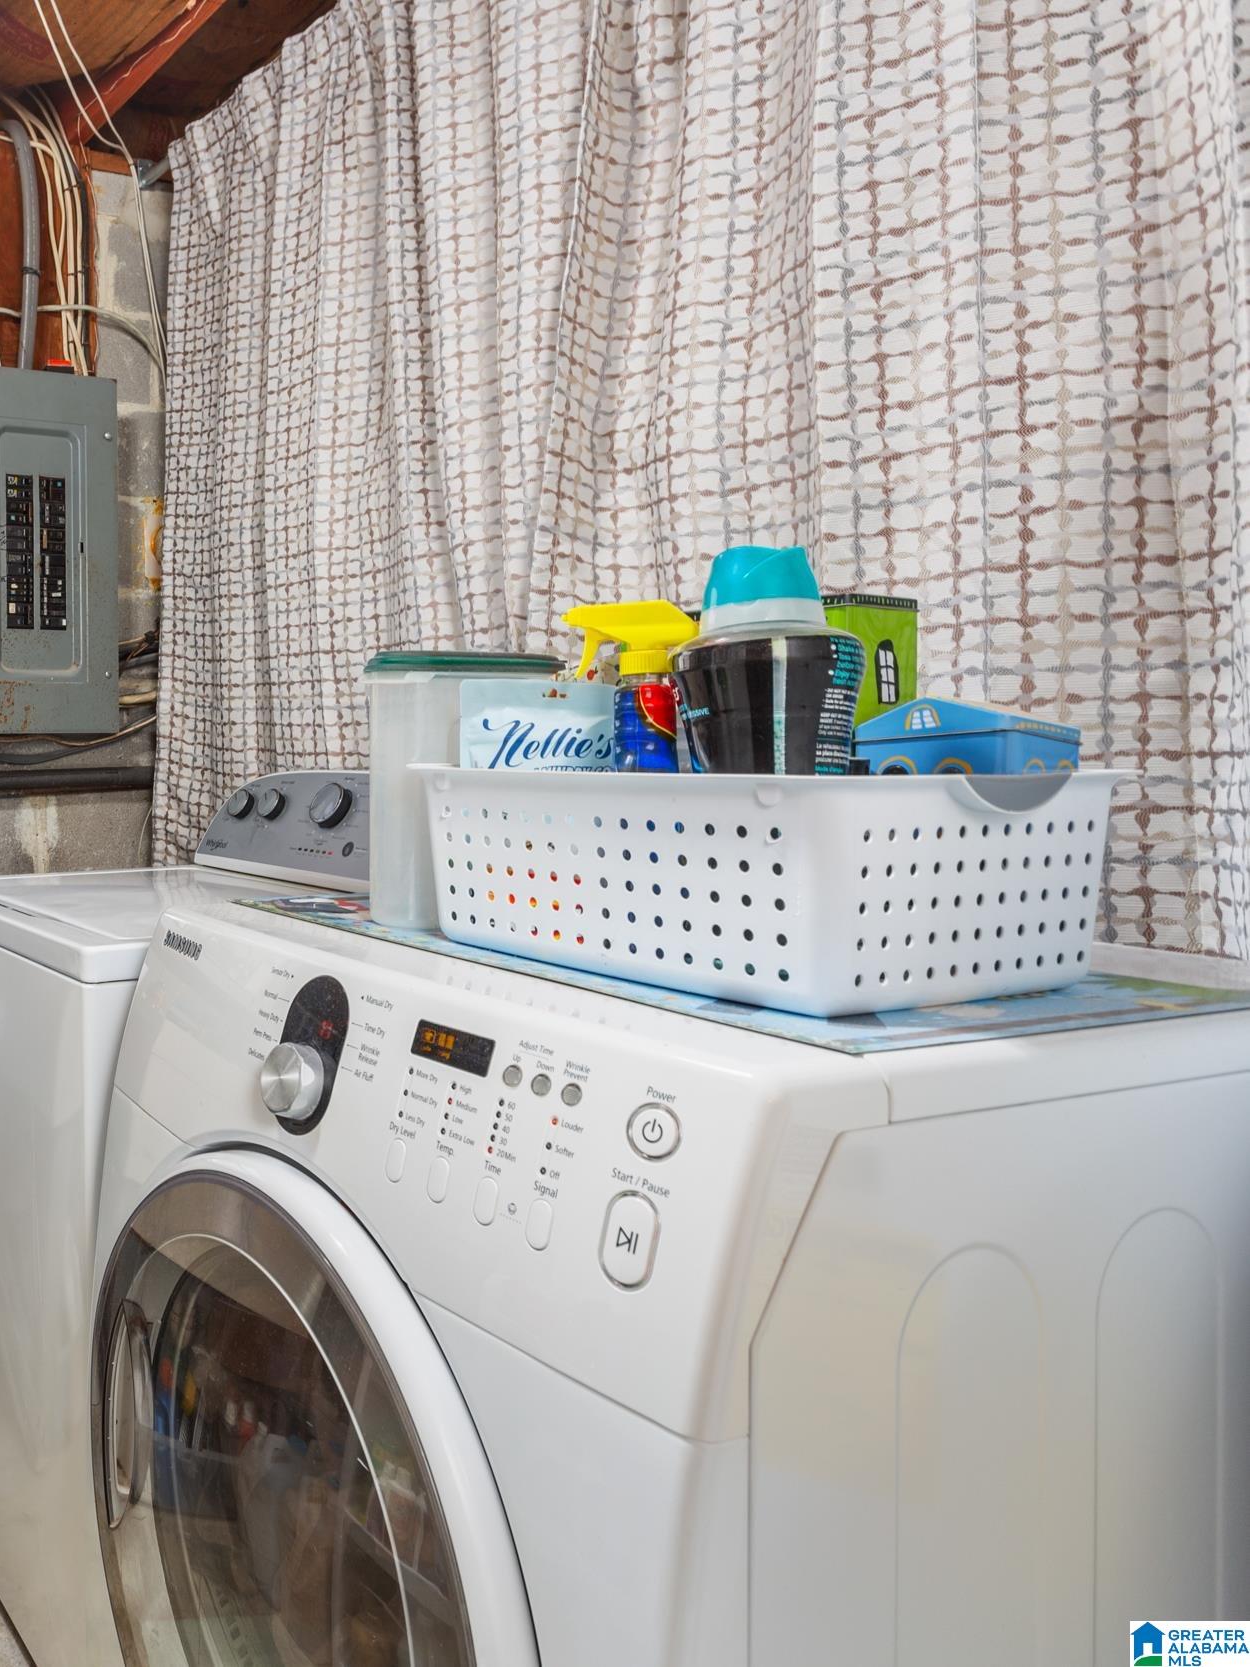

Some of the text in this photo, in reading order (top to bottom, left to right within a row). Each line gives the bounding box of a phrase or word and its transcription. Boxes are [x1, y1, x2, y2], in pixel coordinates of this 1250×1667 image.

[482, 718, 614, 770] Nellie's
[163, 930, 203, 960] SAMSUNG
[366, 995, 394, 1011] Manual Dry
[364, 1022, 386, 1038] Time Dry
[519, 1040, 555, 1056] Adjust Time
[512, 1054, 522, 1063] Up
[536, 1060, 555, 1073] Down
[566, 1059, 591, 1074] Wrinkle
[429, 1073, 438, 1084] Dry
[564, 1068, 588, 1082] Prevent
[459, 1084, 472, 1096] High
[646, 1086, 676, 1103] Power
[429, 1096, 438, 1108] Dry
[456, 1100, 478, 1114] Medium
[508, 1101, 516, 1111] 60
[416, 1116, 425, 1128] Dry
[452, 1114, 464, 1125] Low
[505, 1113, 514, 1122] 50
[389, 1121, 416, 1140] Dry Level
[502, 1126, 510, 1134] 40
[561, 1120, 584, 1134] Louder
[449, 1130, 475, 1146] Extra Low
[499, 1137, 508, 1146] 30
[555, 1144, 575, 1159] Softer
[484, 1160, 502, 1175] Time
[550, 1170, 561, 1180] Off
[533, 1180, 559, 1200] Signal
[611, 1167, 634, 1186] Start
[641, 1178, 671, 1199] Pause
